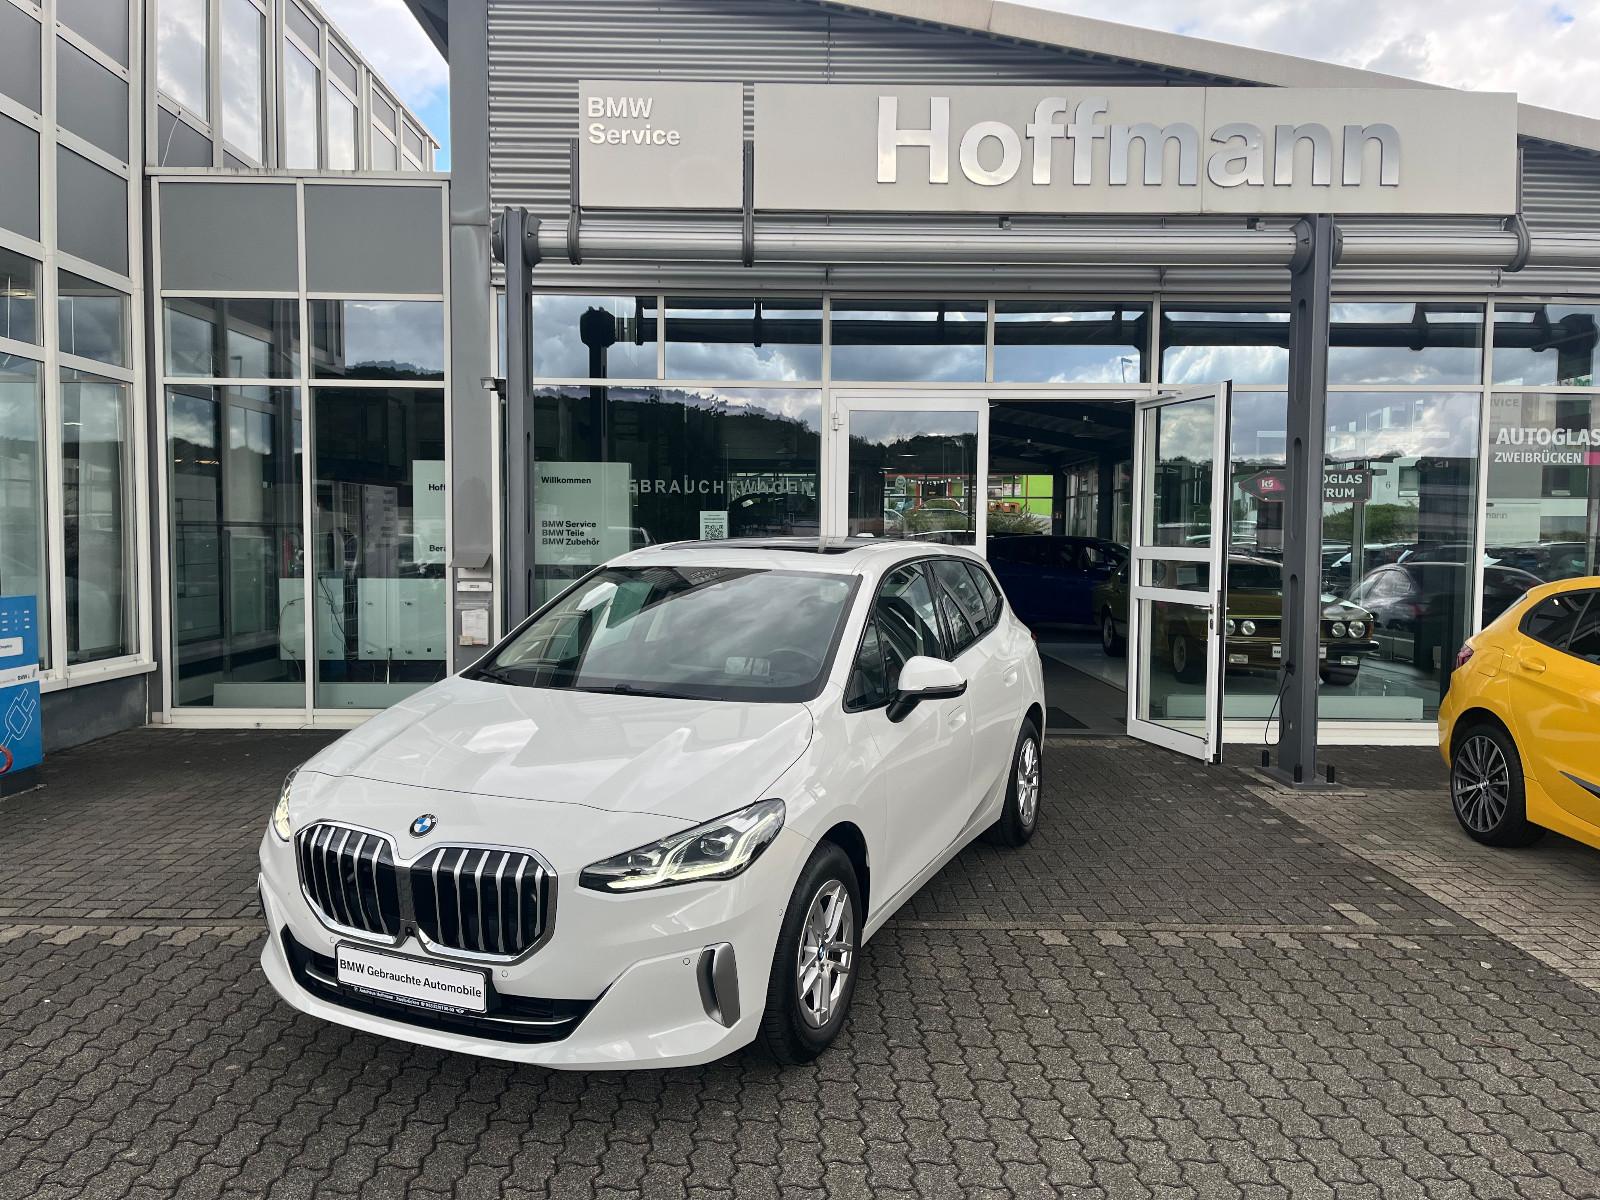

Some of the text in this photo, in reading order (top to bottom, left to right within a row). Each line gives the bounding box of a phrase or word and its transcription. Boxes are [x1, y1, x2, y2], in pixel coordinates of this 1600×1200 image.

[587, 96, 653, 119] BMW
[588, 122, 681, 147] Service
[876, 95, 1401, 188] Hoffmann
[1494, 449, 1582, 464] ZWEIBRÜCKEN
[541, 476, 592, 484] Willkommen
[565, 520, 597, 528] Service
[541, 529, 585, 537] BMW Teile
[565, 538, 600, 546] Zubehör
[339, 958, 483, 998] BMW Gebrauchte Automobile
